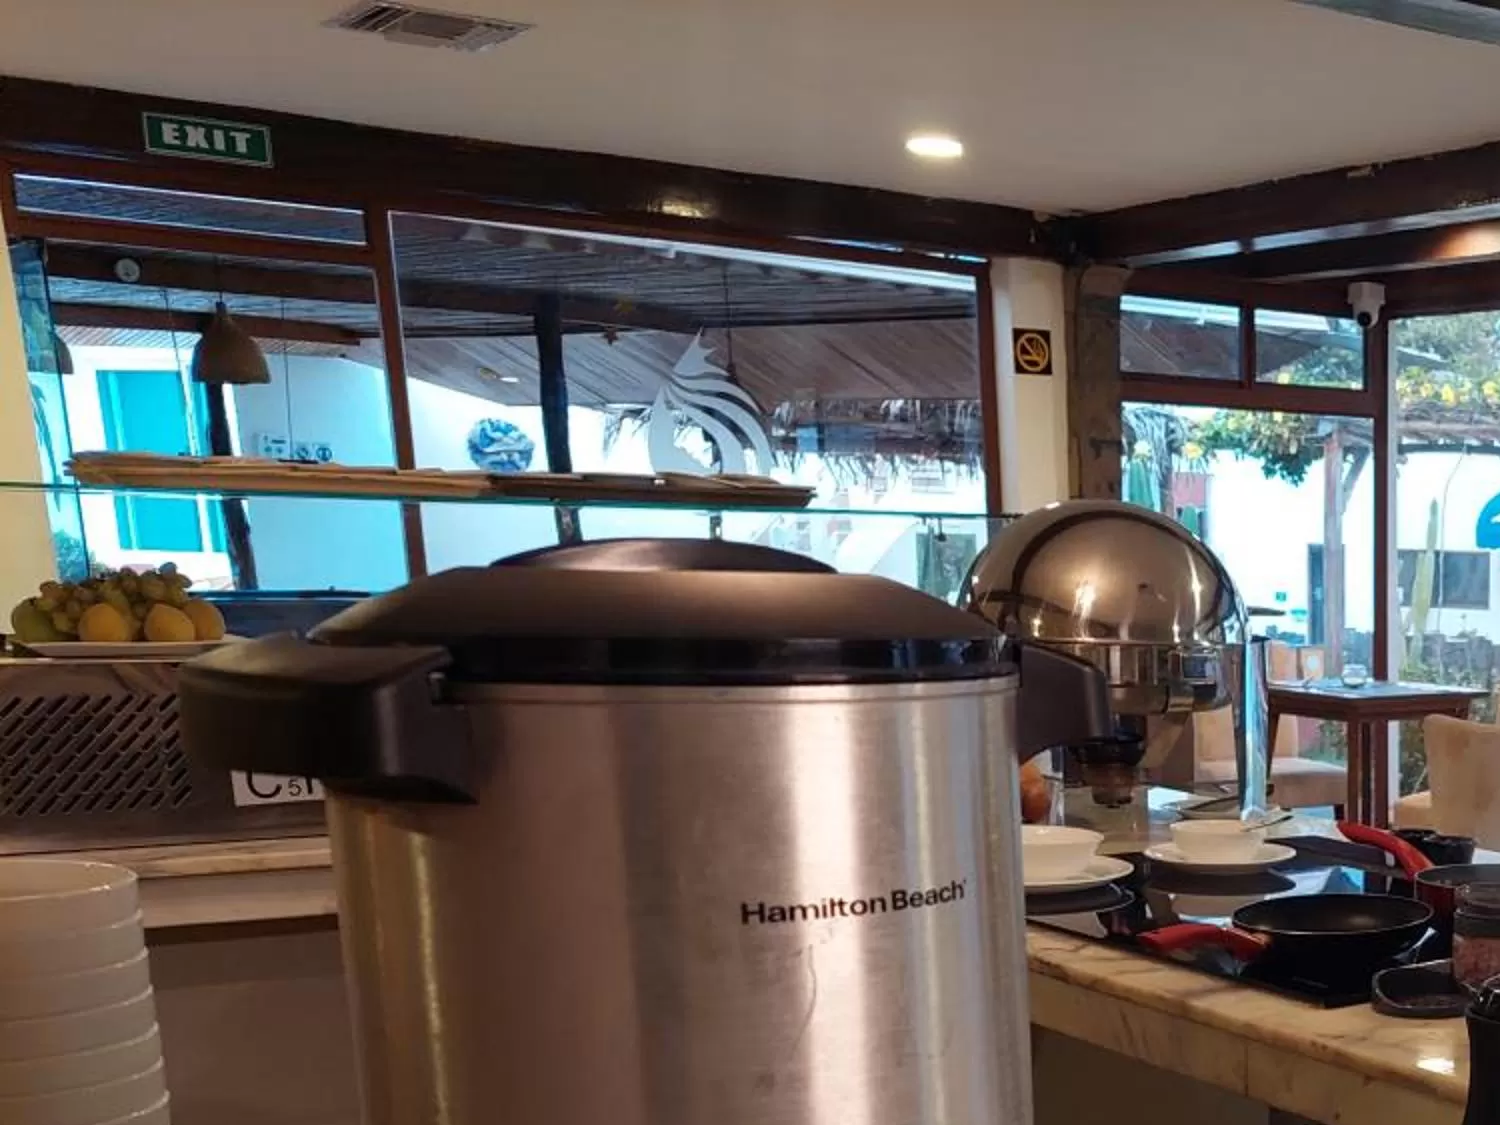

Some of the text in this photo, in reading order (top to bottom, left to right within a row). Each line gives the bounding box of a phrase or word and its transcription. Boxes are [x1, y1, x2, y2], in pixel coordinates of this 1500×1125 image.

[161, 121, 251, 153] EXIT
[740, 880, 965, 925] Hamilton Beach
